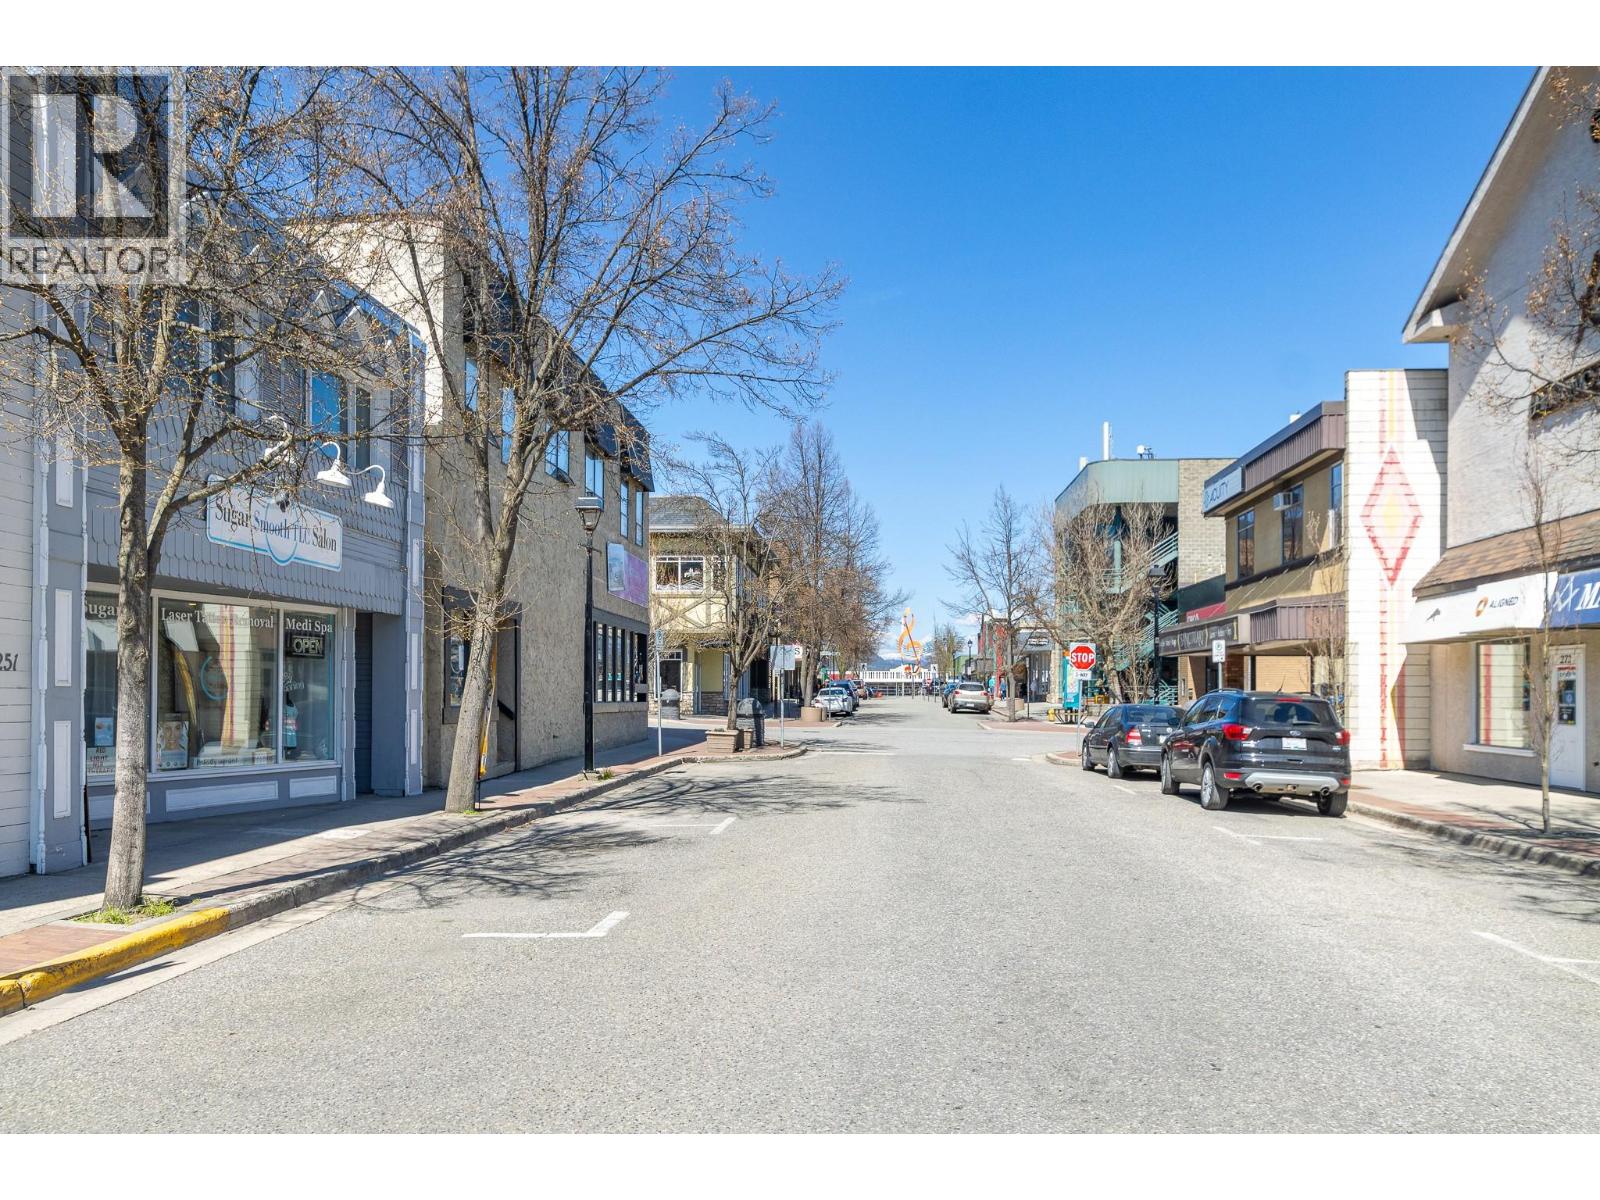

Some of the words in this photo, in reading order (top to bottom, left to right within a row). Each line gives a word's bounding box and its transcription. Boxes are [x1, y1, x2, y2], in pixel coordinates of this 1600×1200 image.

[215, 494, 250, 533] Sugar
[253, 510, 290, 540] Smooth
[312, 526, 337, 552] Salon
[1489, 596, 1519, 609] ALIGNED
[1574, 581, 1600, 612] M
[161, 607, 193, 621] Laser
[285, 617, 312, 631] Medi
[314, 620, 333, 635] Spa
[293, 638, 323, 654] OPEN
[1071, 653, 1095, 663] STOP
